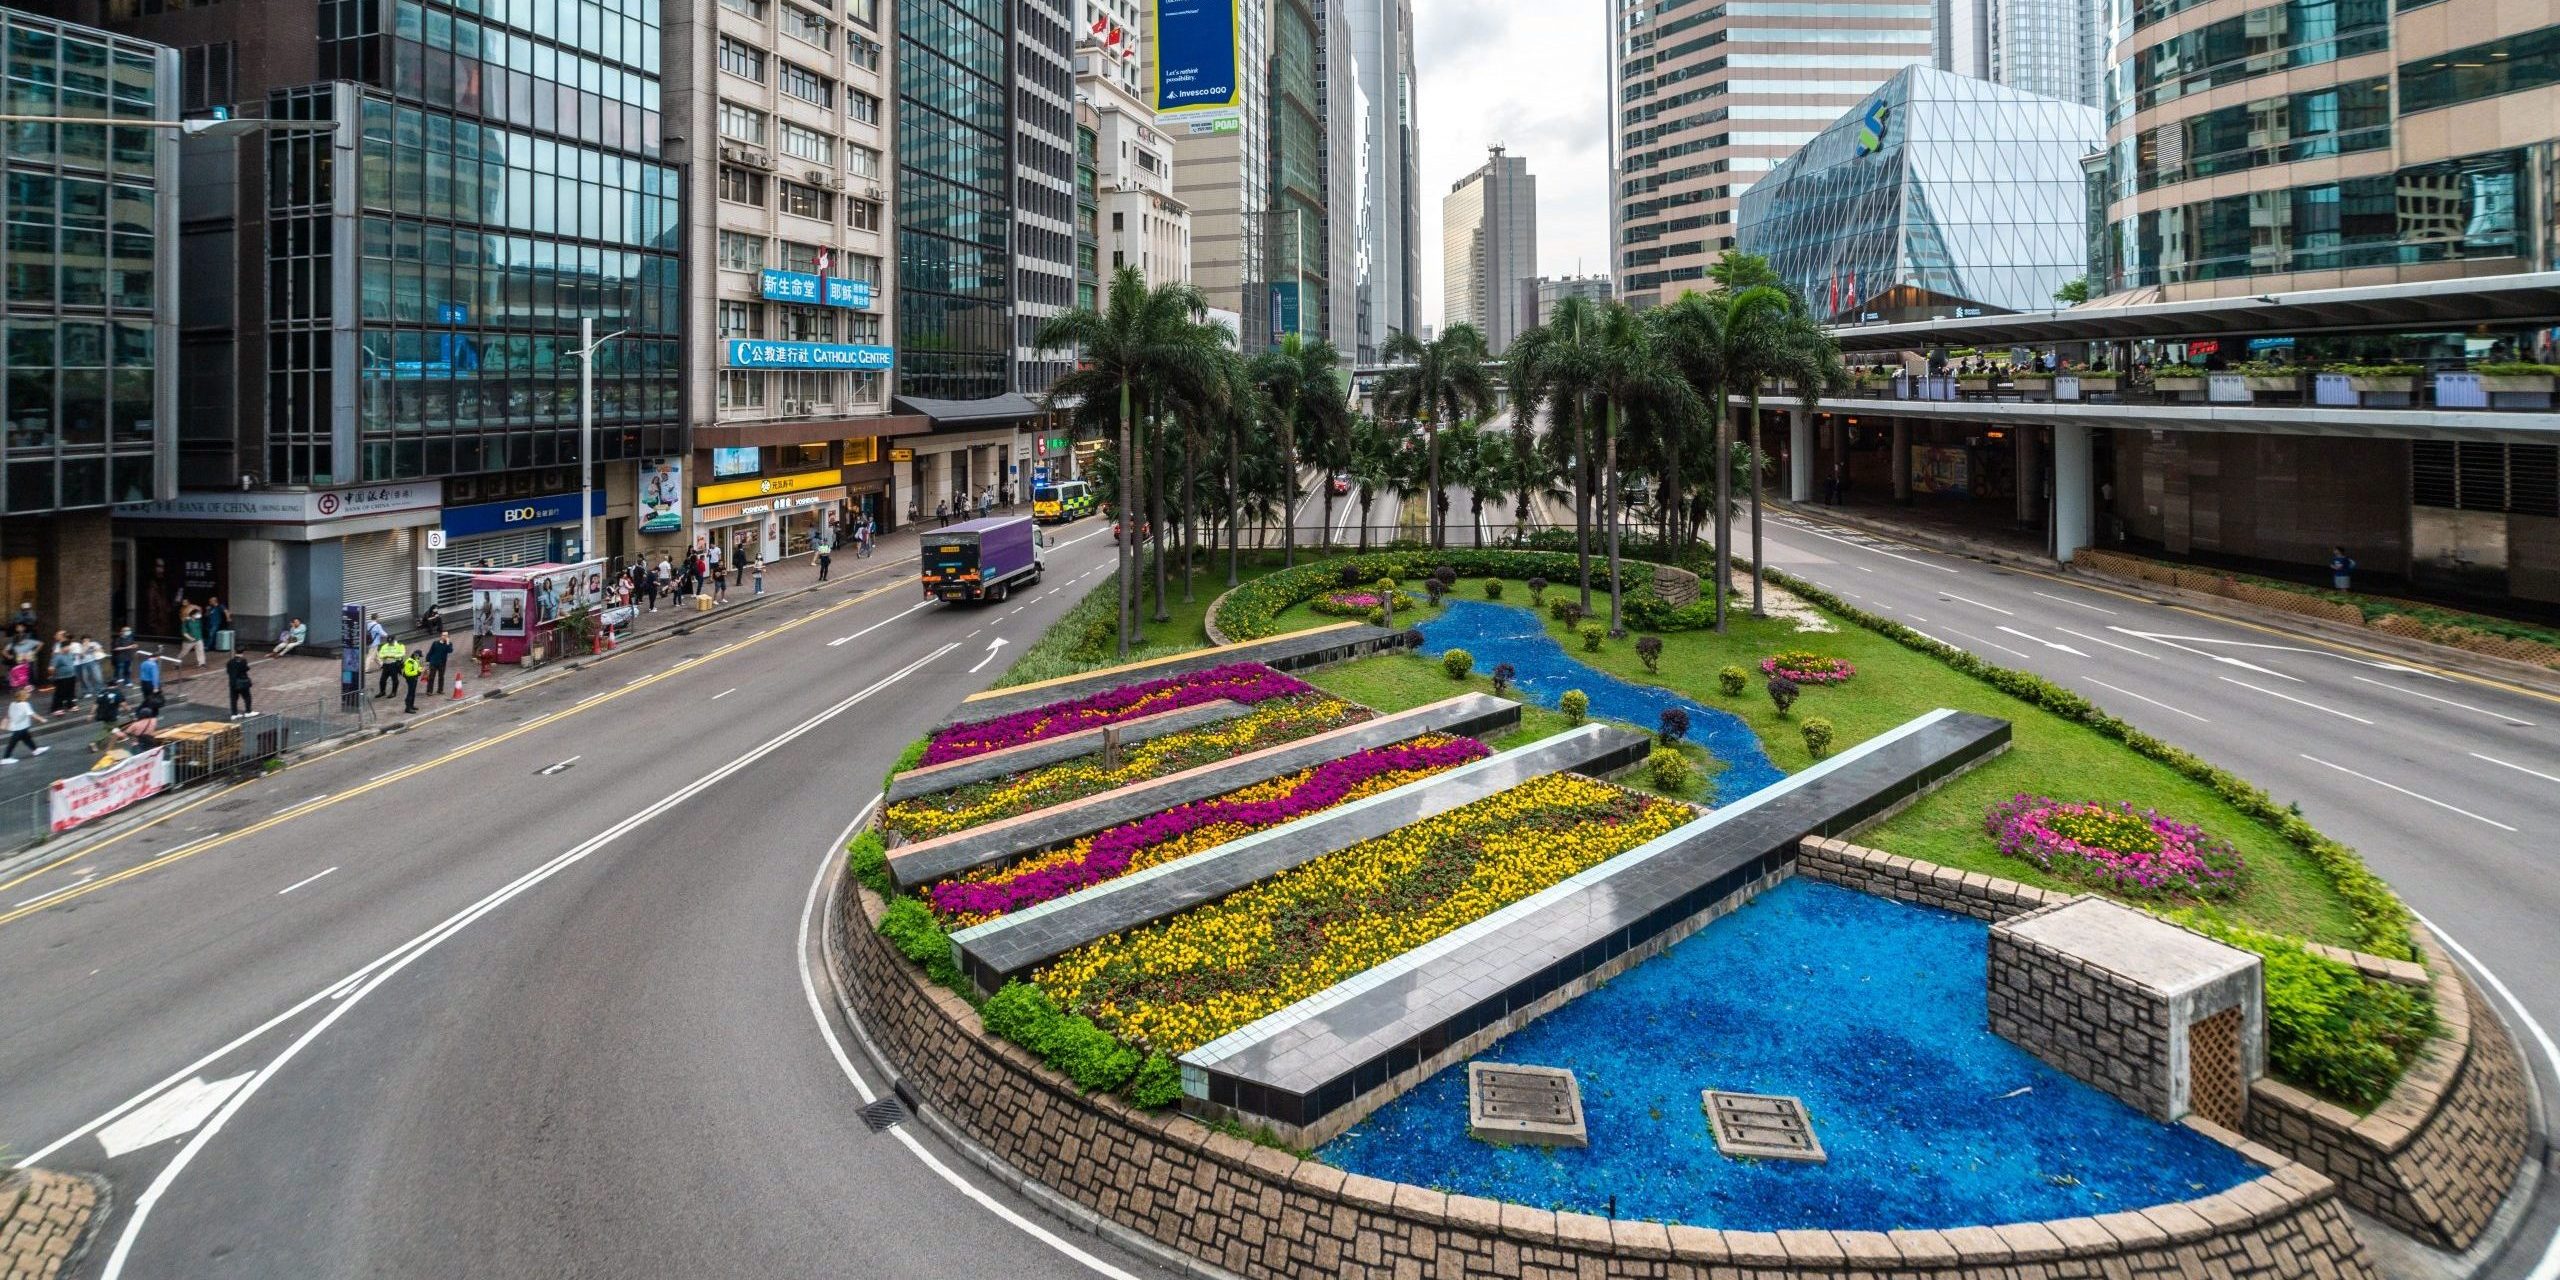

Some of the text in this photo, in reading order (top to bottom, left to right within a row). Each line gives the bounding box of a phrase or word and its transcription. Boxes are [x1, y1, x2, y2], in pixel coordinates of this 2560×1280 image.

[1180, 89, 1209, 97] Invesco
[1215, 119, 1238, 130] POAD
[765, 275, 815, 298] 新生命堂
[752, 346, 809, 363] 公教進行社
[813, 349, 857, 363] CATHOLIC
[858, 350, 890, 364] CENTRE
[179, 502, 205, 513] BANK
[207, 502, 219, 512] OF
[223, 502, 256, 513] CHINA
[505, 507, 535, 522] BDO
